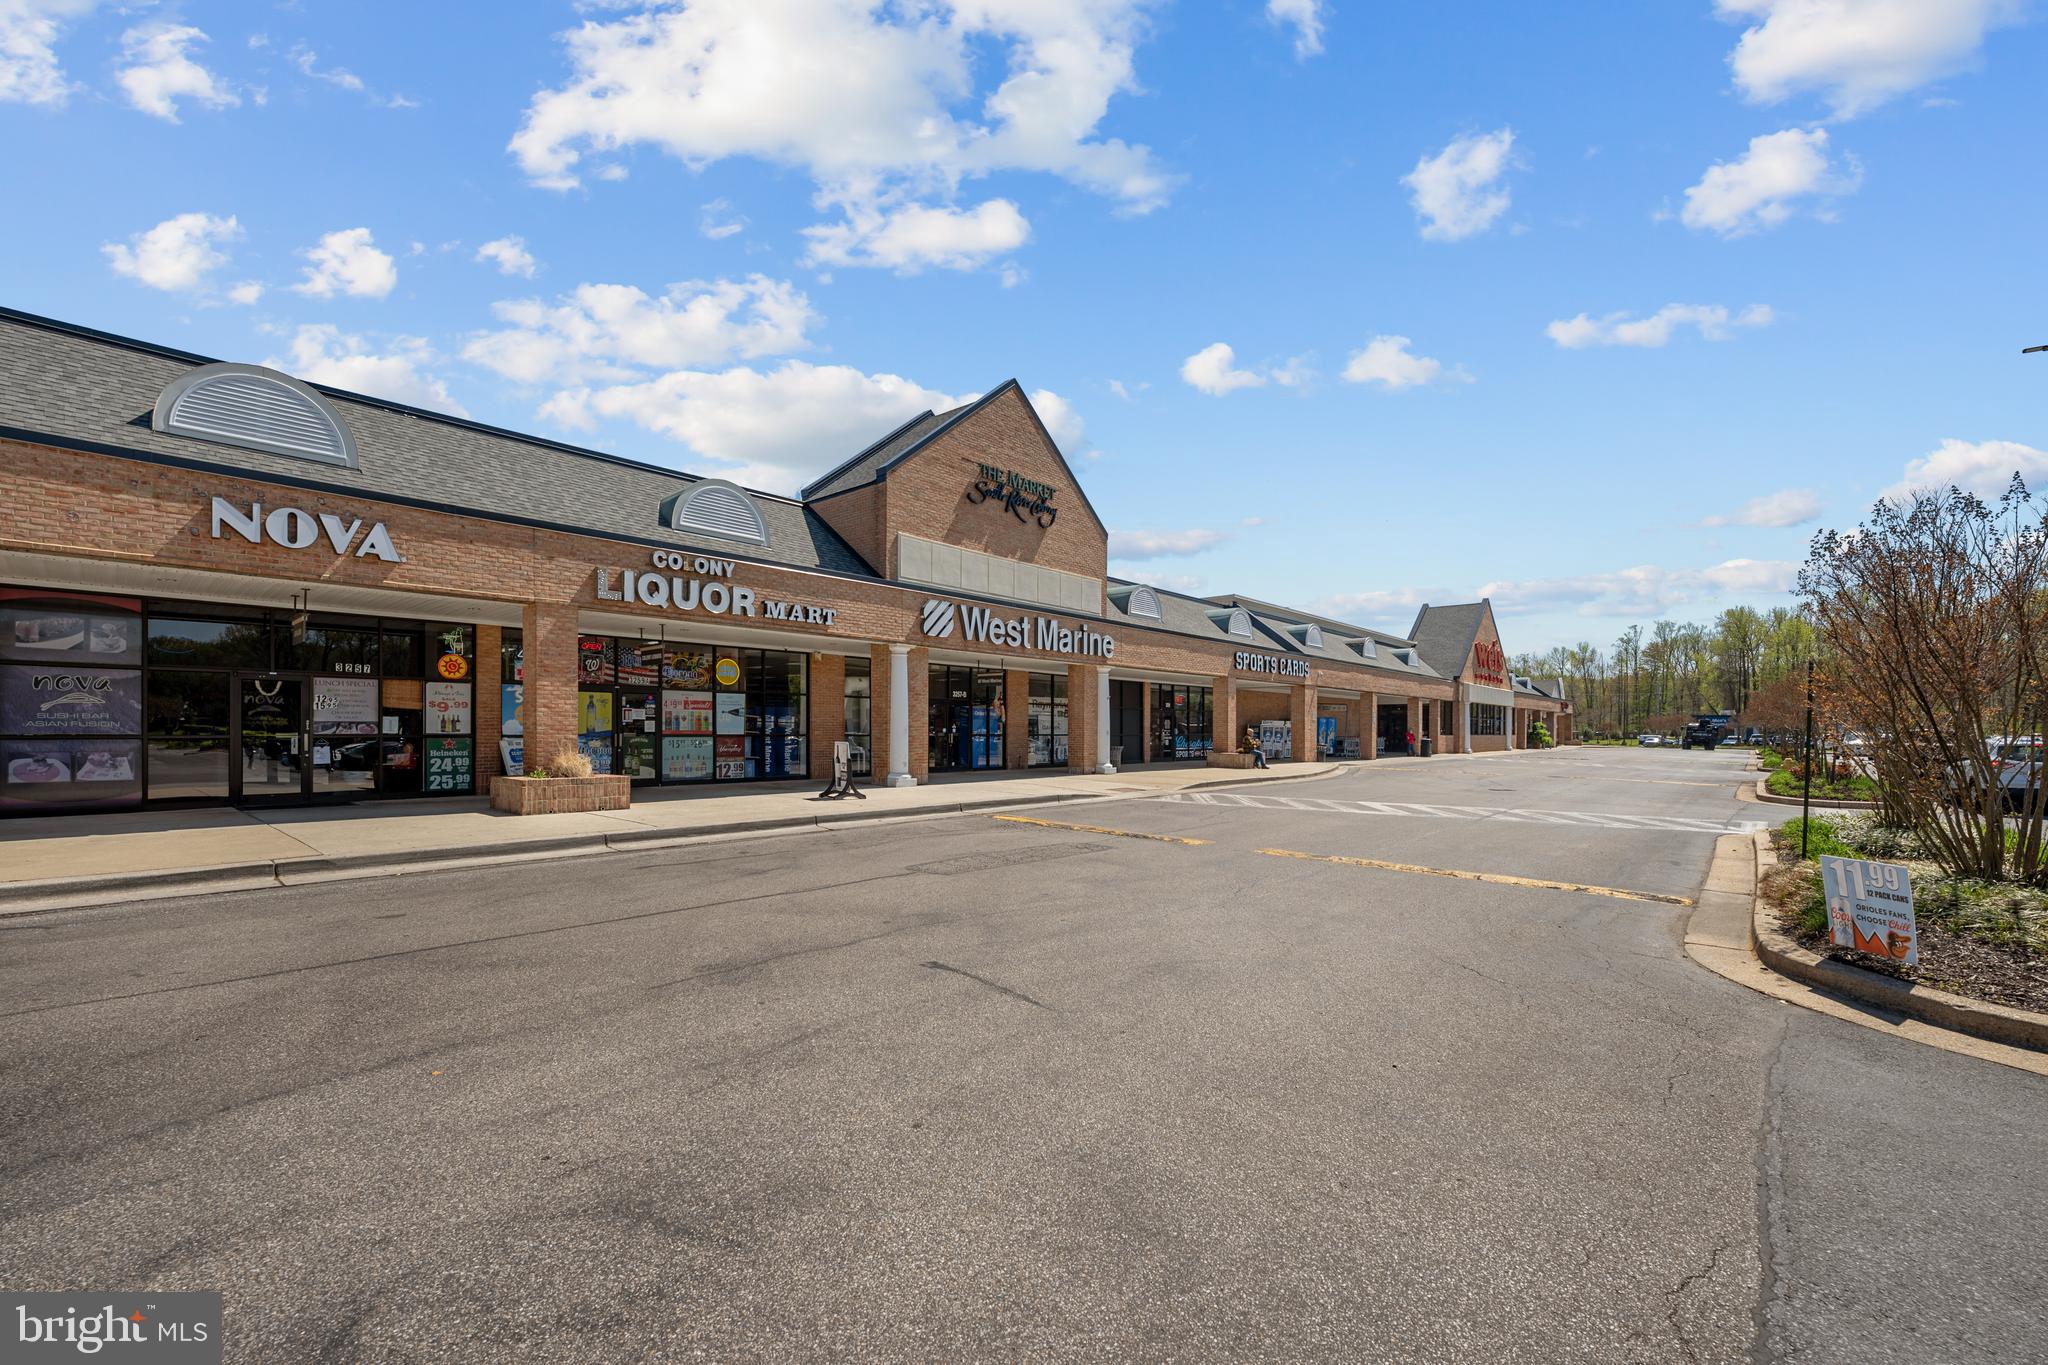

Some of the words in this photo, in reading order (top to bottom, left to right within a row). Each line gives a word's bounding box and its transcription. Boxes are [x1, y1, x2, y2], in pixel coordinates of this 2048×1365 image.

[980, 464, 1003, 484] THE
[1008, 470, 1056, 500] MARKET
[212, 496, 401, 563] NOVA
[597, 567, 756, 617] LIQUOR
[764, 600, 837, 625] MART
[960, 604, 1031, 648] West
[1037, 617, 1114, 658] Marine
[581, 642, 602, 650] OPEN
[335, 663, 371, 673] 3257
[1236, 652, 1277, 674] SPORTS
[1280, 658, 1310, 677] CARDS
[32, 675, 112, 691] nova
[428, 701, 468, 712] $9.99
[430, 758, 469, 772] 24.99
[717, 763, 744, 777] 12.99
[430, 775, 470, 790] 25.99
[1830, 860, 1899, 901] 11.99
[1866, 889, 1874, 898] 12
[1875, 891, 1891, 901] PACK
[1892, 894, 1909, 904] CANS
[1856, 903, 1887, 916] ORIOLES
[1888, 911, 1910, 921] FANS,
[1856, 914, 1887, 927] CHOOSE
[1888, 919, 1911, 931] Chill
